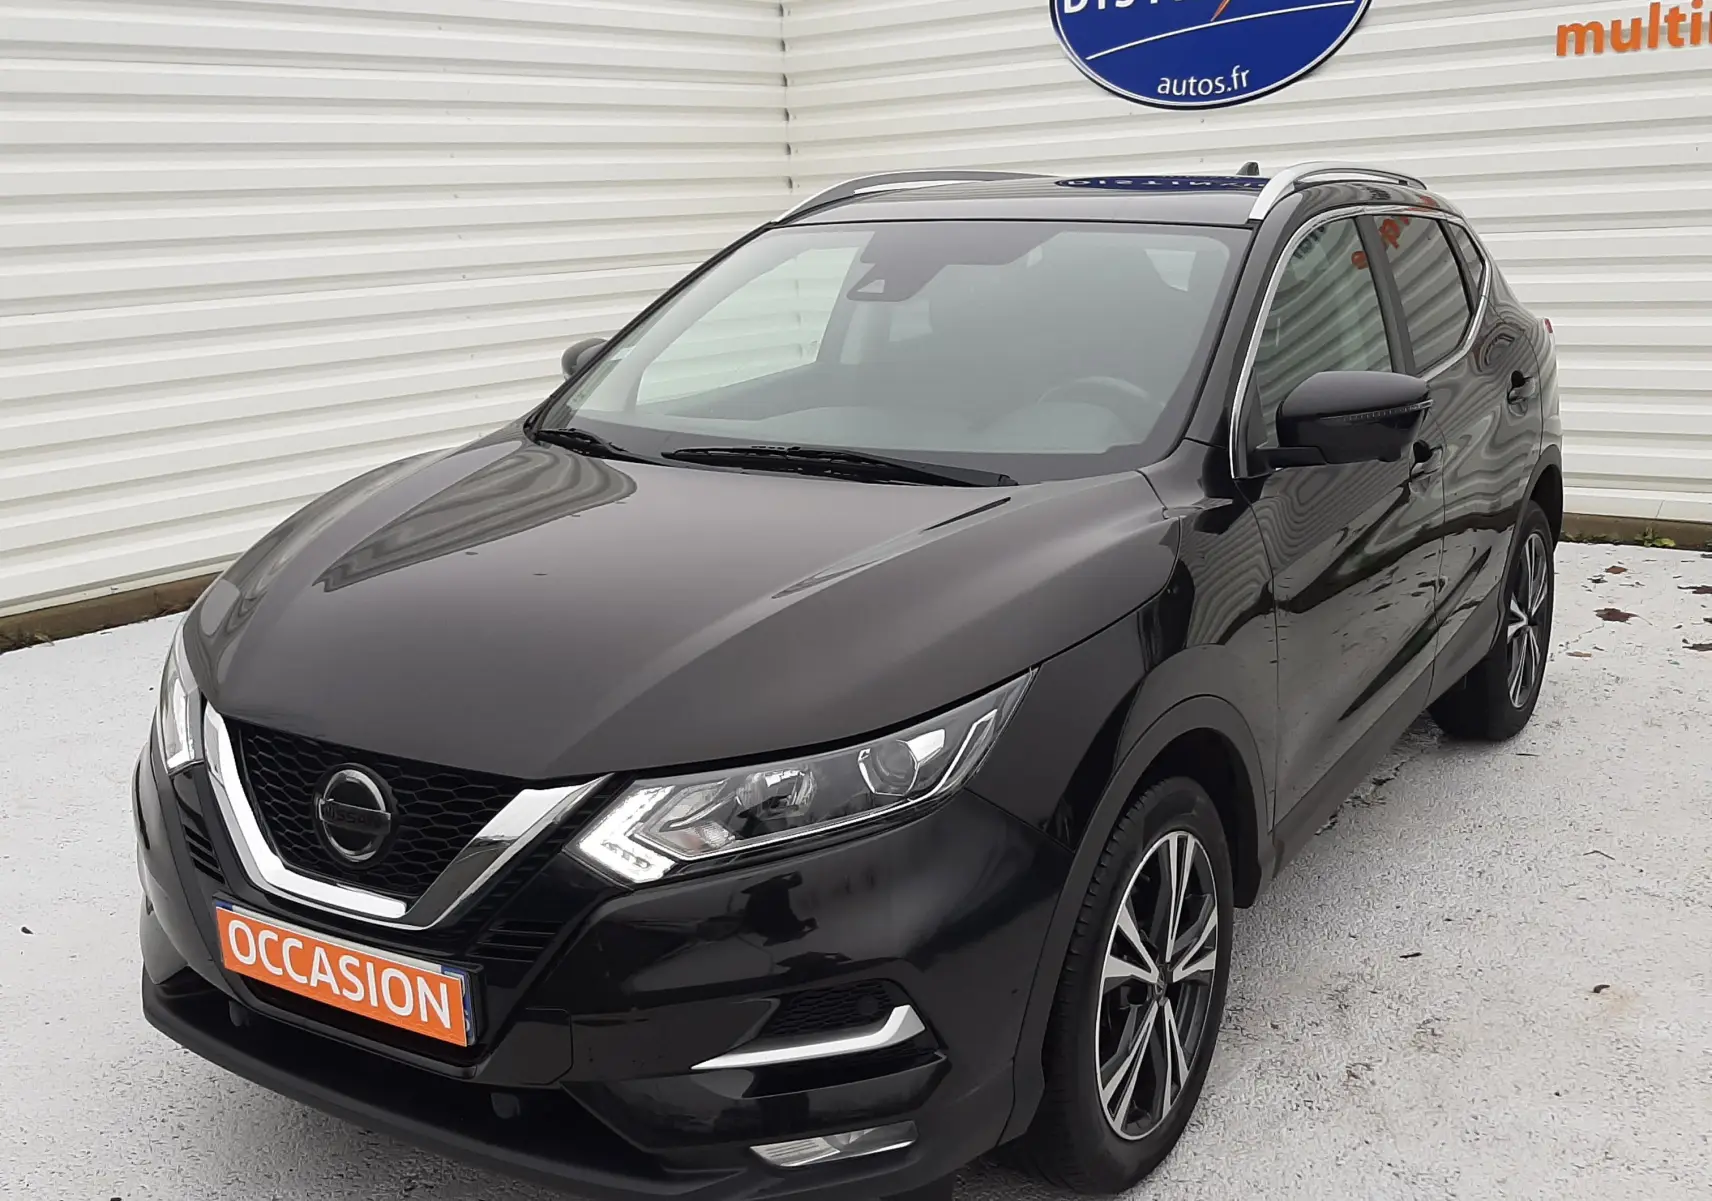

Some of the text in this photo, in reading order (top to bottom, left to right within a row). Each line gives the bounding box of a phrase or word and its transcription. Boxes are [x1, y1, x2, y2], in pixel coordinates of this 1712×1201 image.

[1556, 0, 1712, 56] multi
[1157, 65, 1249, 95] autos.fr
[228, 919, 451, 1029] OCCASION
